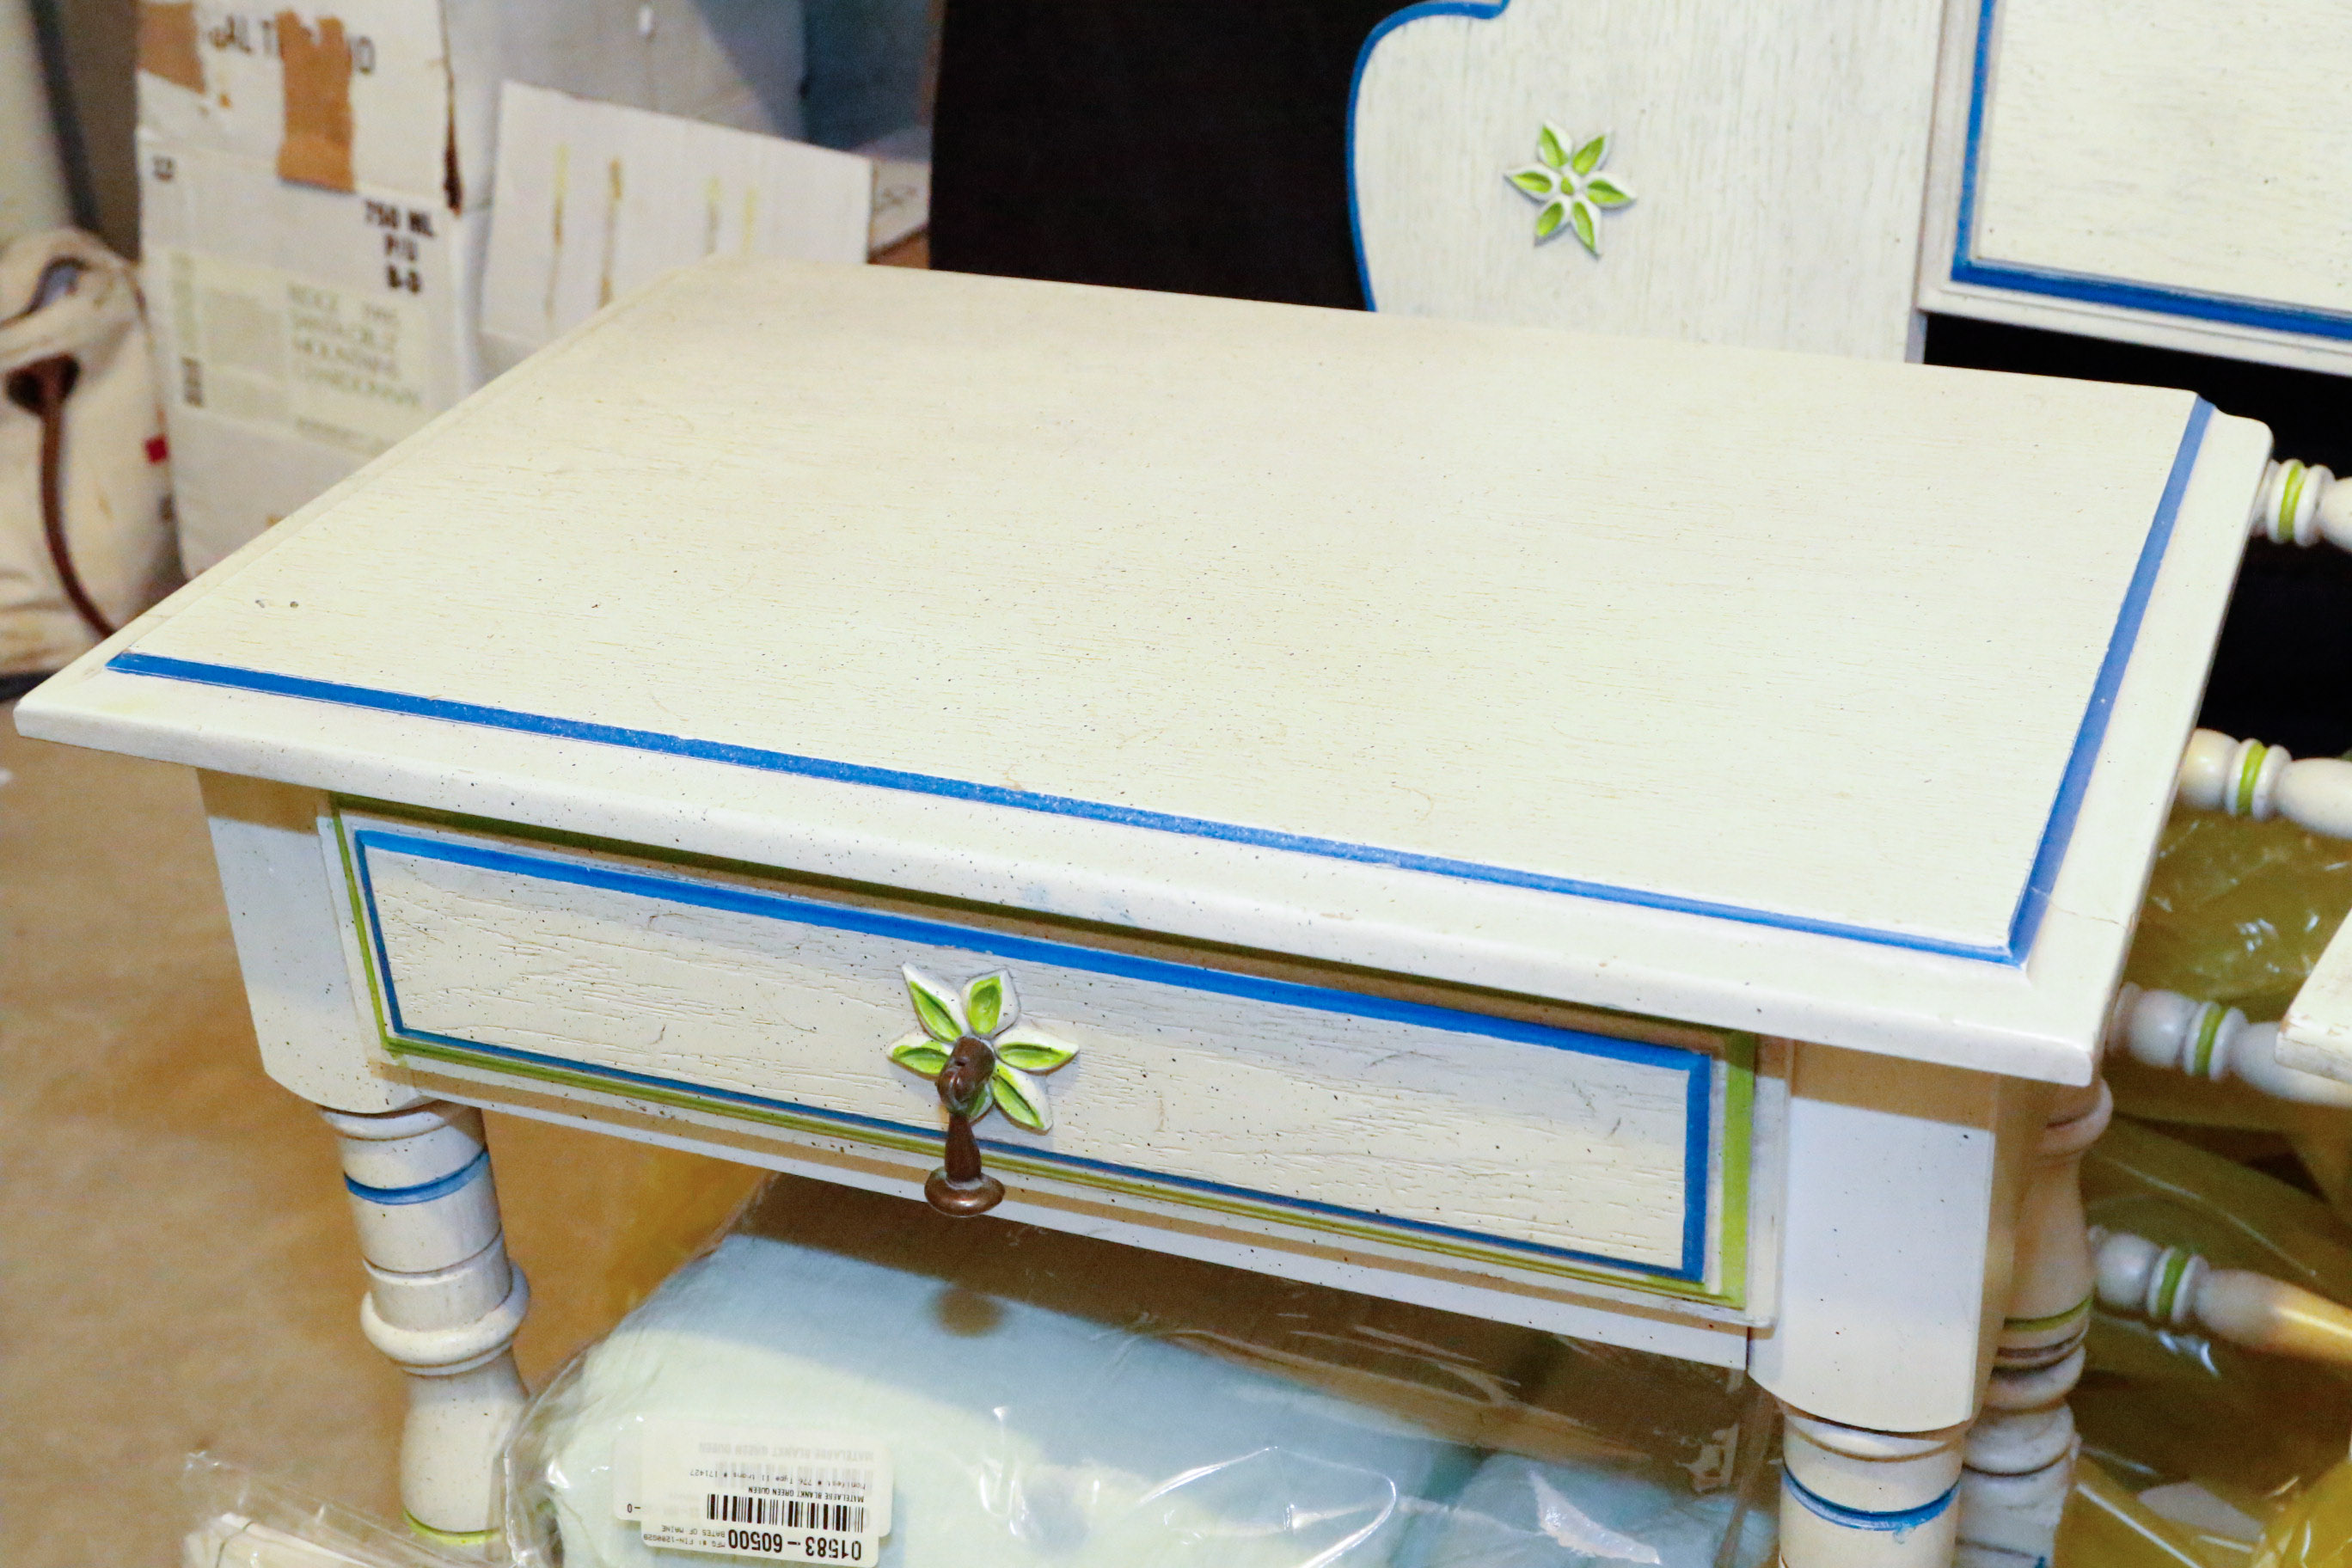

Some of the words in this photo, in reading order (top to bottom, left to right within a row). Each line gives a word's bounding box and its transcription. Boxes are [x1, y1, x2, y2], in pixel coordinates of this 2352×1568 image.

[364, 199, 400, 230] 750
[748, 1485, 770, 1495] QUEEN
[772, 1487, 795, 1498] GREEN
[661, 1525, 684, 1534] MAINE
[688, 1528, 698, 1536] OF
[701, 1528, 726, 1538] BATES
[728, 1529, 783, 1553] 60500
[805, 1536, 862, 1561] 01583
